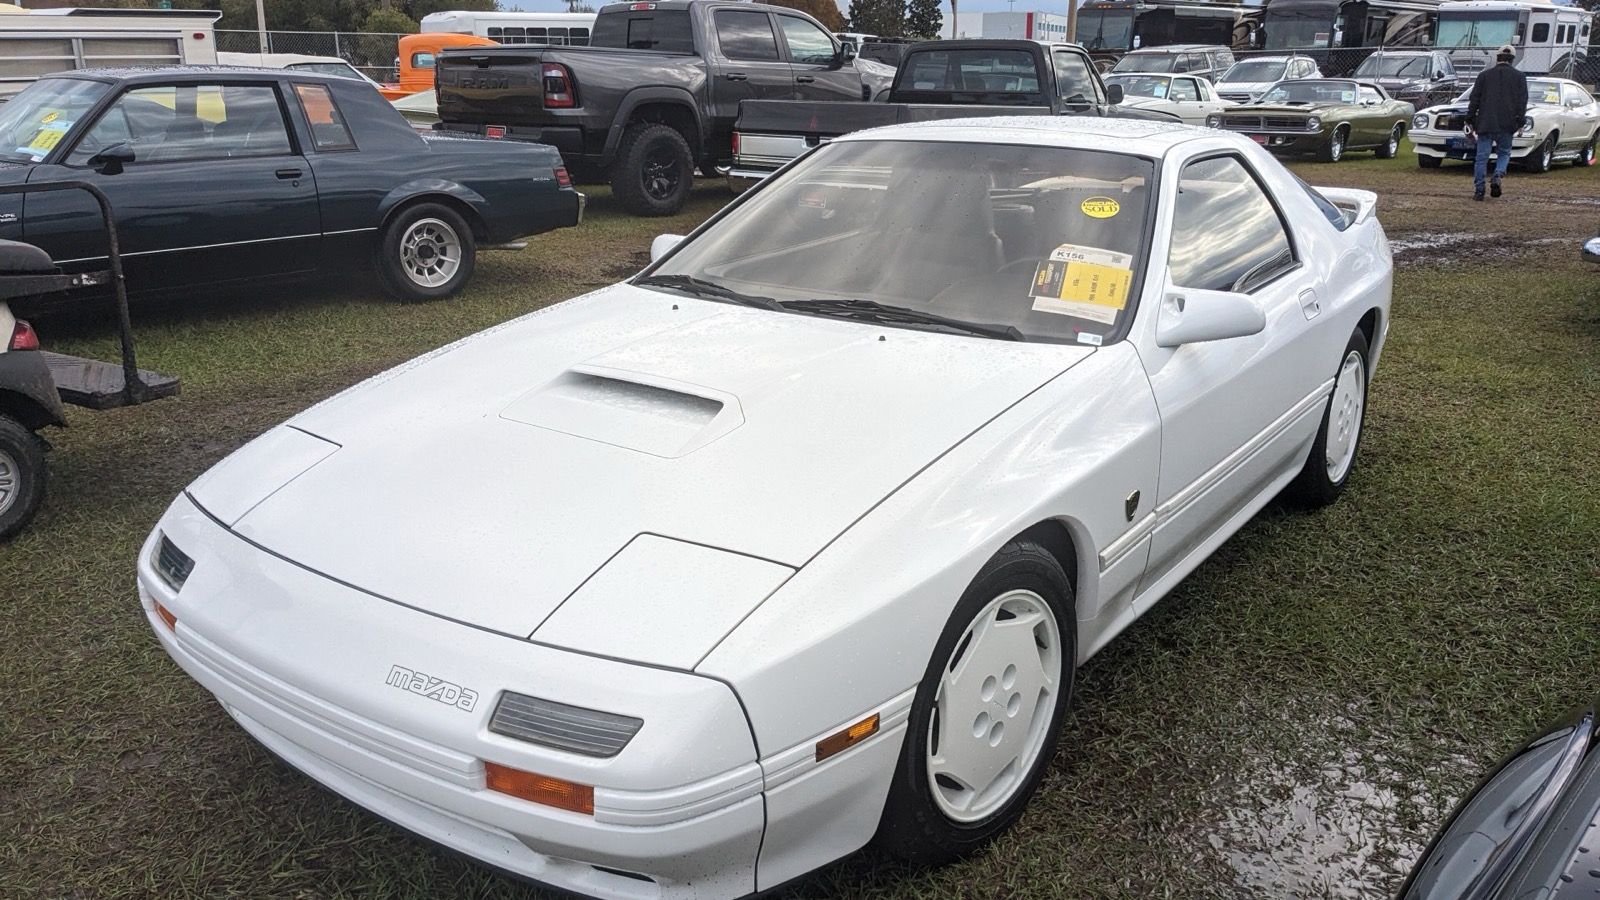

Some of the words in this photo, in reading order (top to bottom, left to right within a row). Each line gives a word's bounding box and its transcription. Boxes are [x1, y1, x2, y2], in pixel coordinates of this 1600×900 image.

[460, 77, 510, 89] RAM
[1084, 205, 1118, 213] SOLD
[1057, 251, 1085, 260] K156
